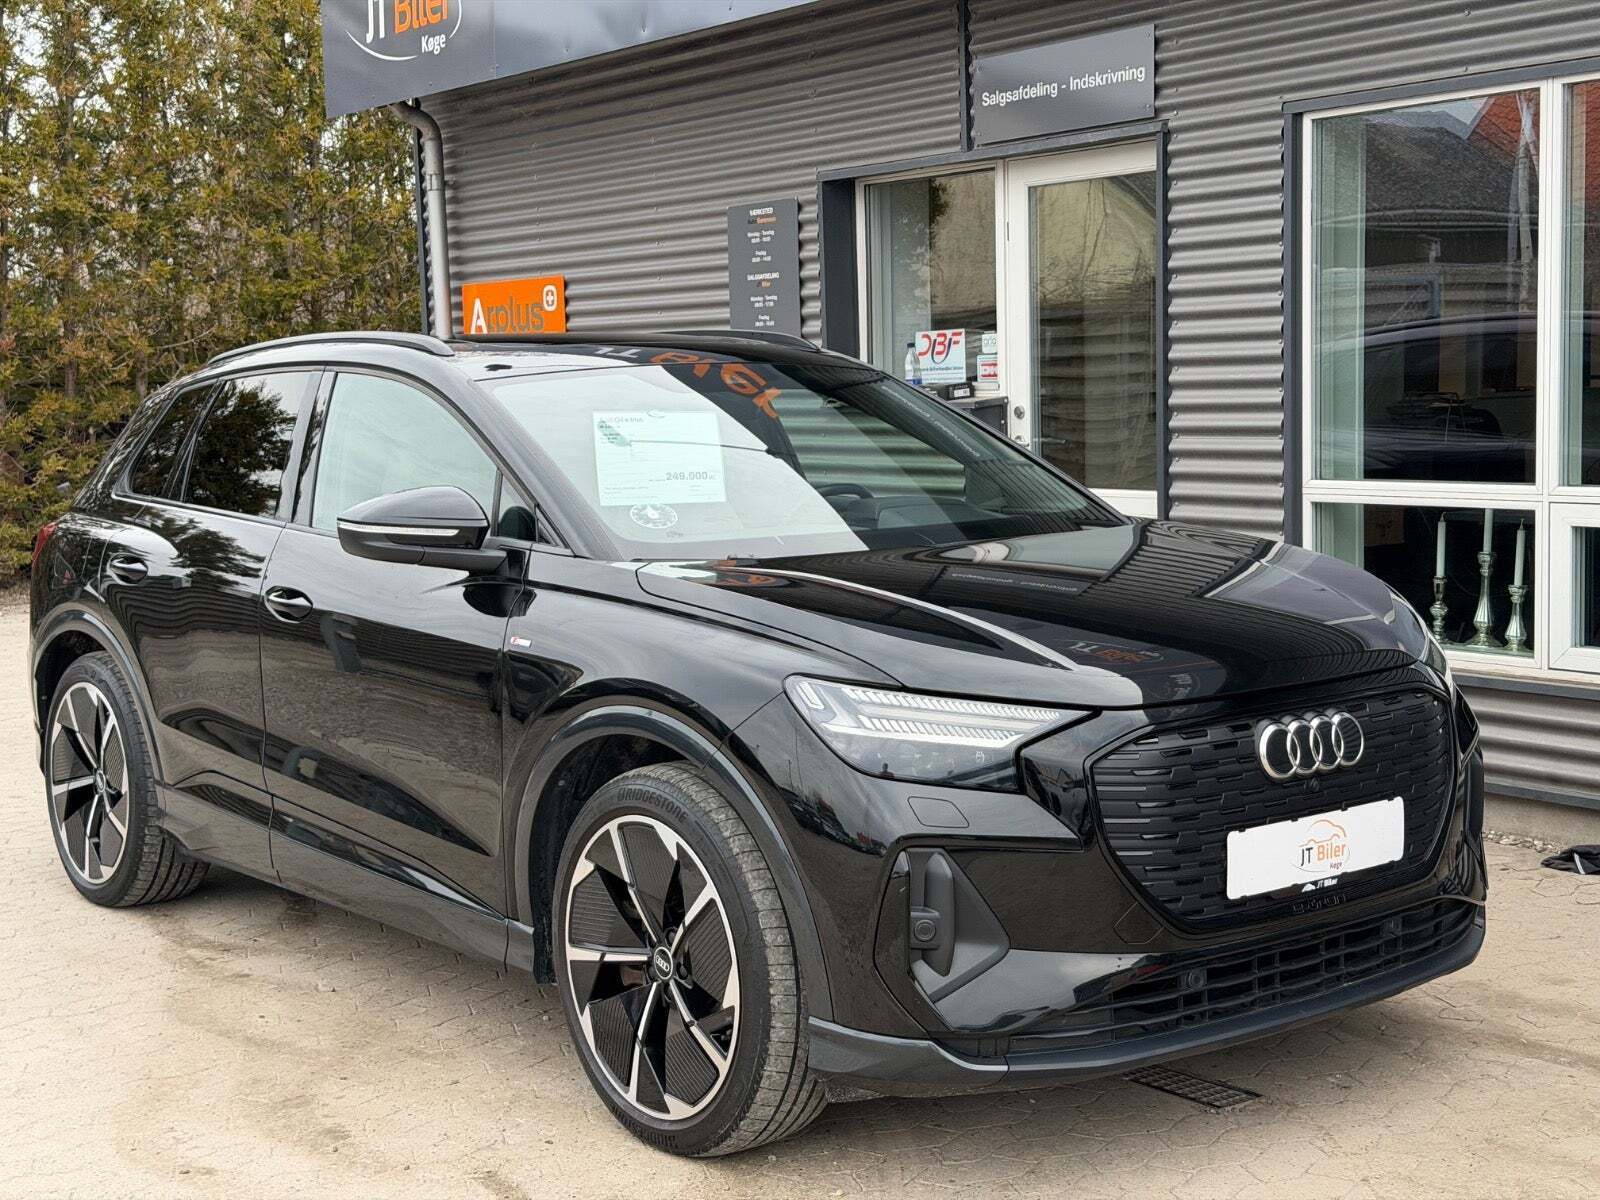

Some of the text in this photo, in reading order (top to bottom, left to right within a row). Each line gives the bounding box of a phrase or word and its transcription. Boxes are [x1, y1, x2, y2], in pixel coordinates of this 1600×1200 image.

[421, 33, 446, 55] Køge
[981, 81, 1058, 107] Salgsafdeling
[1069, 66, 1146, 91] Indskrivning
[618, 788, 689, 823] BRIDGESTONE
[1300, 842, 1346, 866] JT Biler
